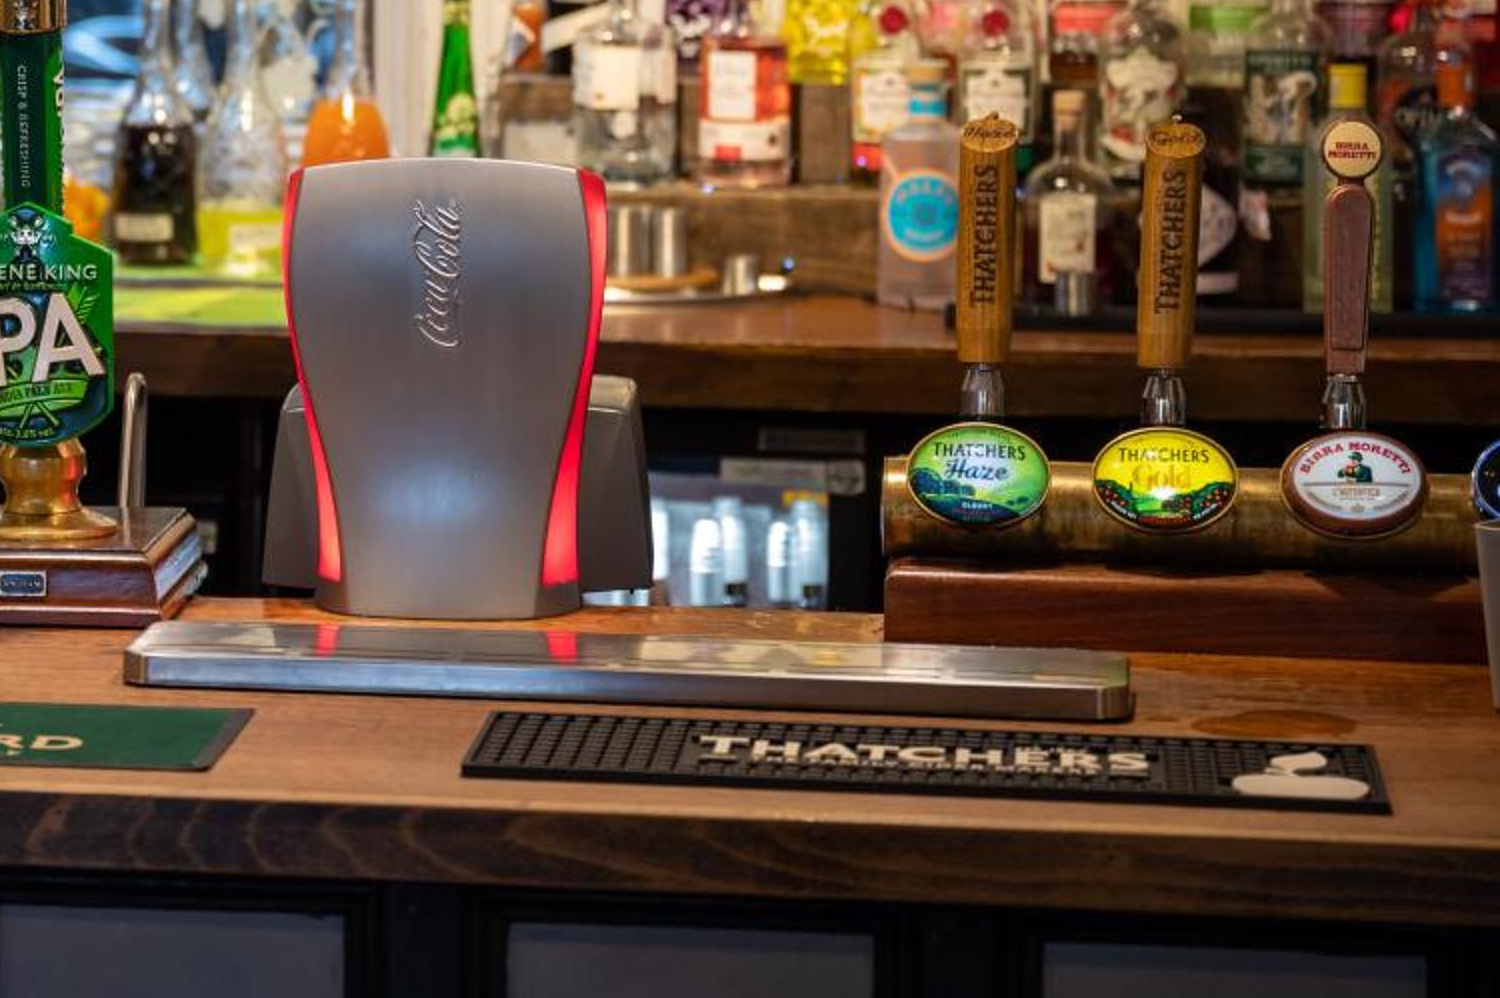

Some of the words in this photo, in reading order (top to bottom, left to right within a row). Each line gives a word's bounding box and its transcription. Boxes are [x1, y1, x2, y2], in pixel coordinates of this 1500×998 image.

[16, 64, 28, 99] CRISP
[969, 164, 998, 309] THATCHERS
[1155, 168, 1187, 315] THATCHERS
[45, 263, 98, 281] KING
[932, 441, 1027, 461] THATCHERS
[1299, 443, 1345, 475] BIRRA
[1347, 441, 1412, 475] MORETTI
[945, 458, 1010, 481] Haze
[698, 734, 1150, 776] THATCHERS
